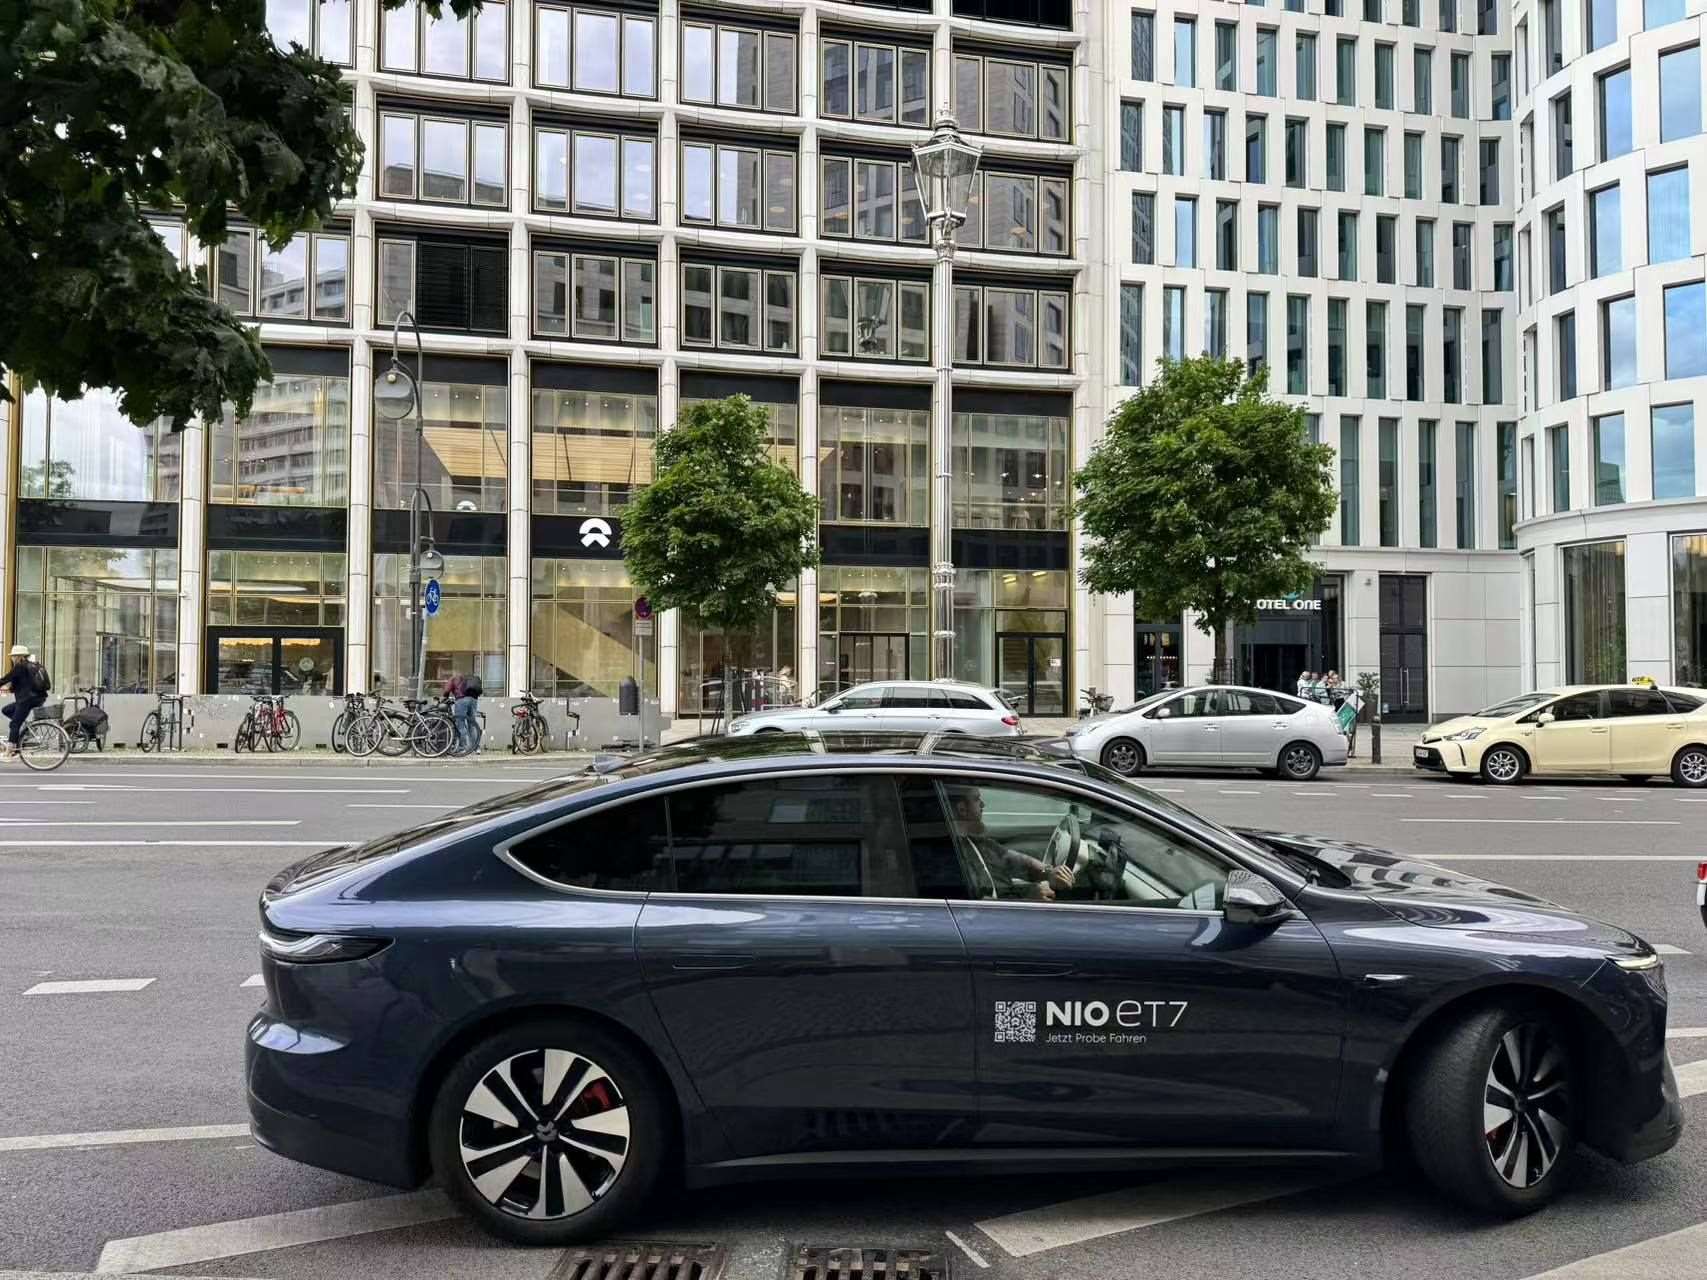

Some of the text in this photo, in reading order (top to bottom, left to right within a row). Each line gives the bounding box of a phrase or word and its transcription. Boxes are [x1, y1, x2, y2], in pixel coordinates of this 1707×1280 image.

[1255, 599, 1291, 610] OTEL
[1046, 1000, 1110, 1027] NIO
[1045, 1033, 1147, 1043] Jetzt Probe Fahren
